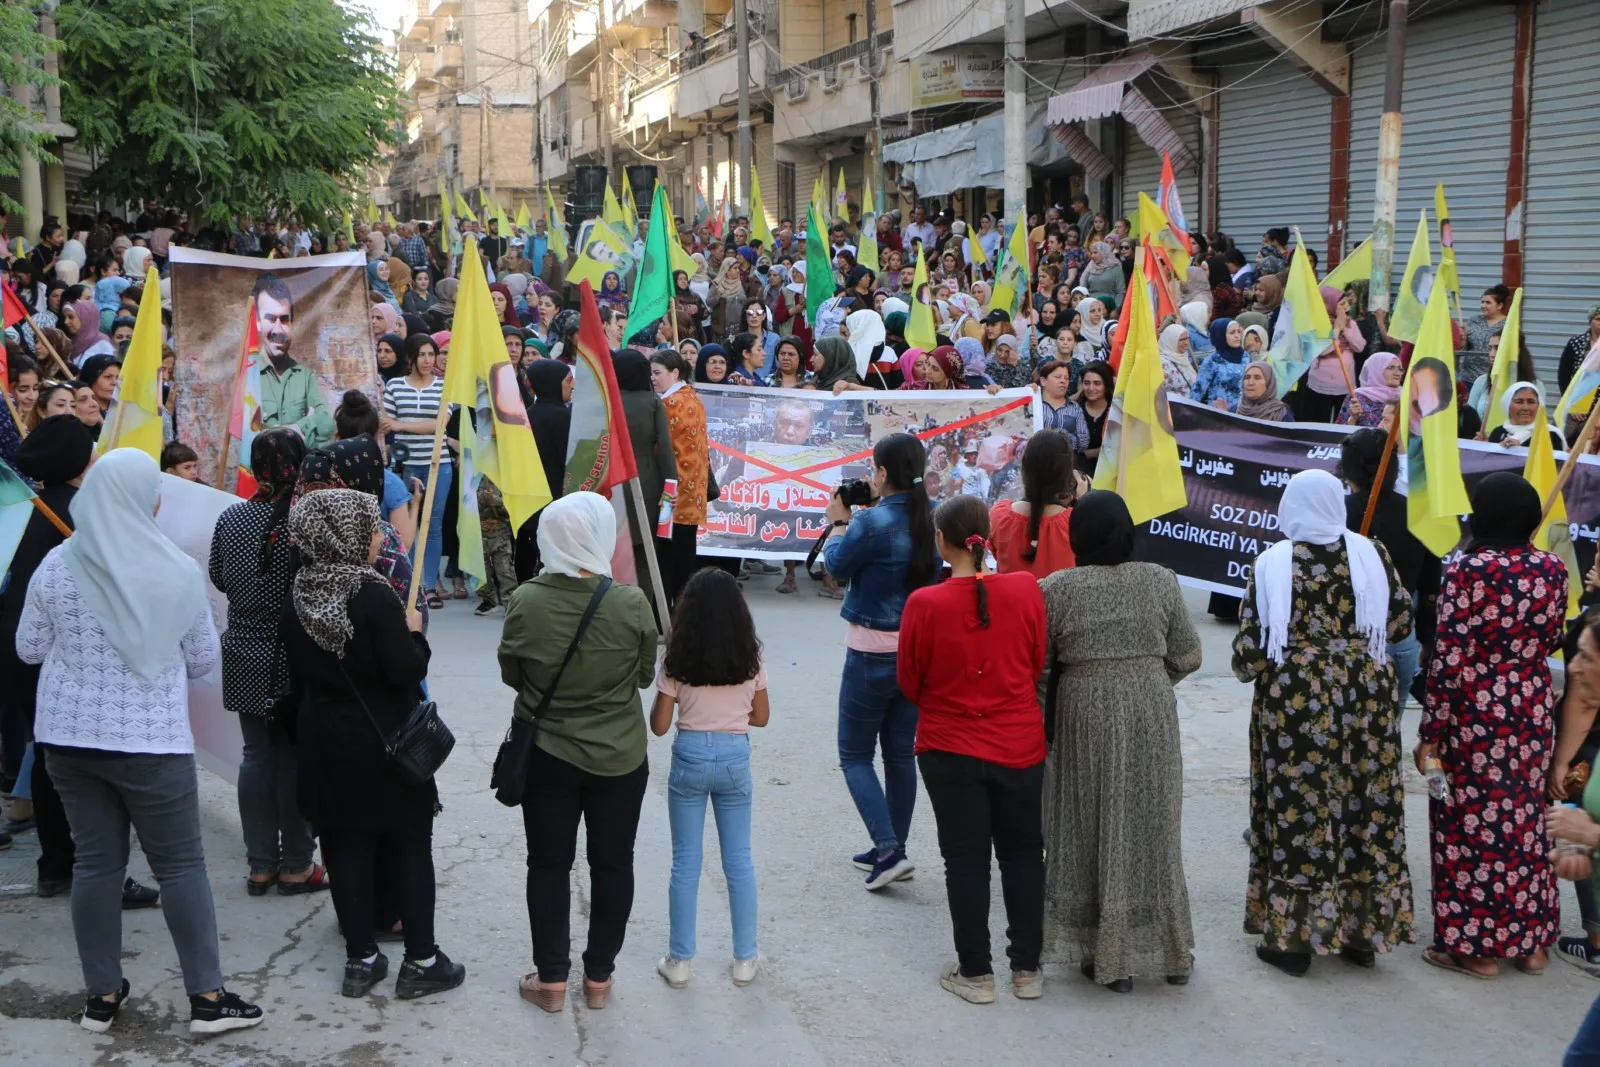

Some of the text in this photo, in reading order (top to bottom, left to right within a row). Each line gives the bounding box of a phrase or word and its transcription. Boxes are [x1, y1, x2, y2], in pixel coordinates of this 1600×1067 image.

[1196, 456, 1235, 477] عفرين
[1210, 503, 1280, 530] SOZ DİD
[760, 520, 790, 543] من
[1239, 535, 1258, 555] YA
